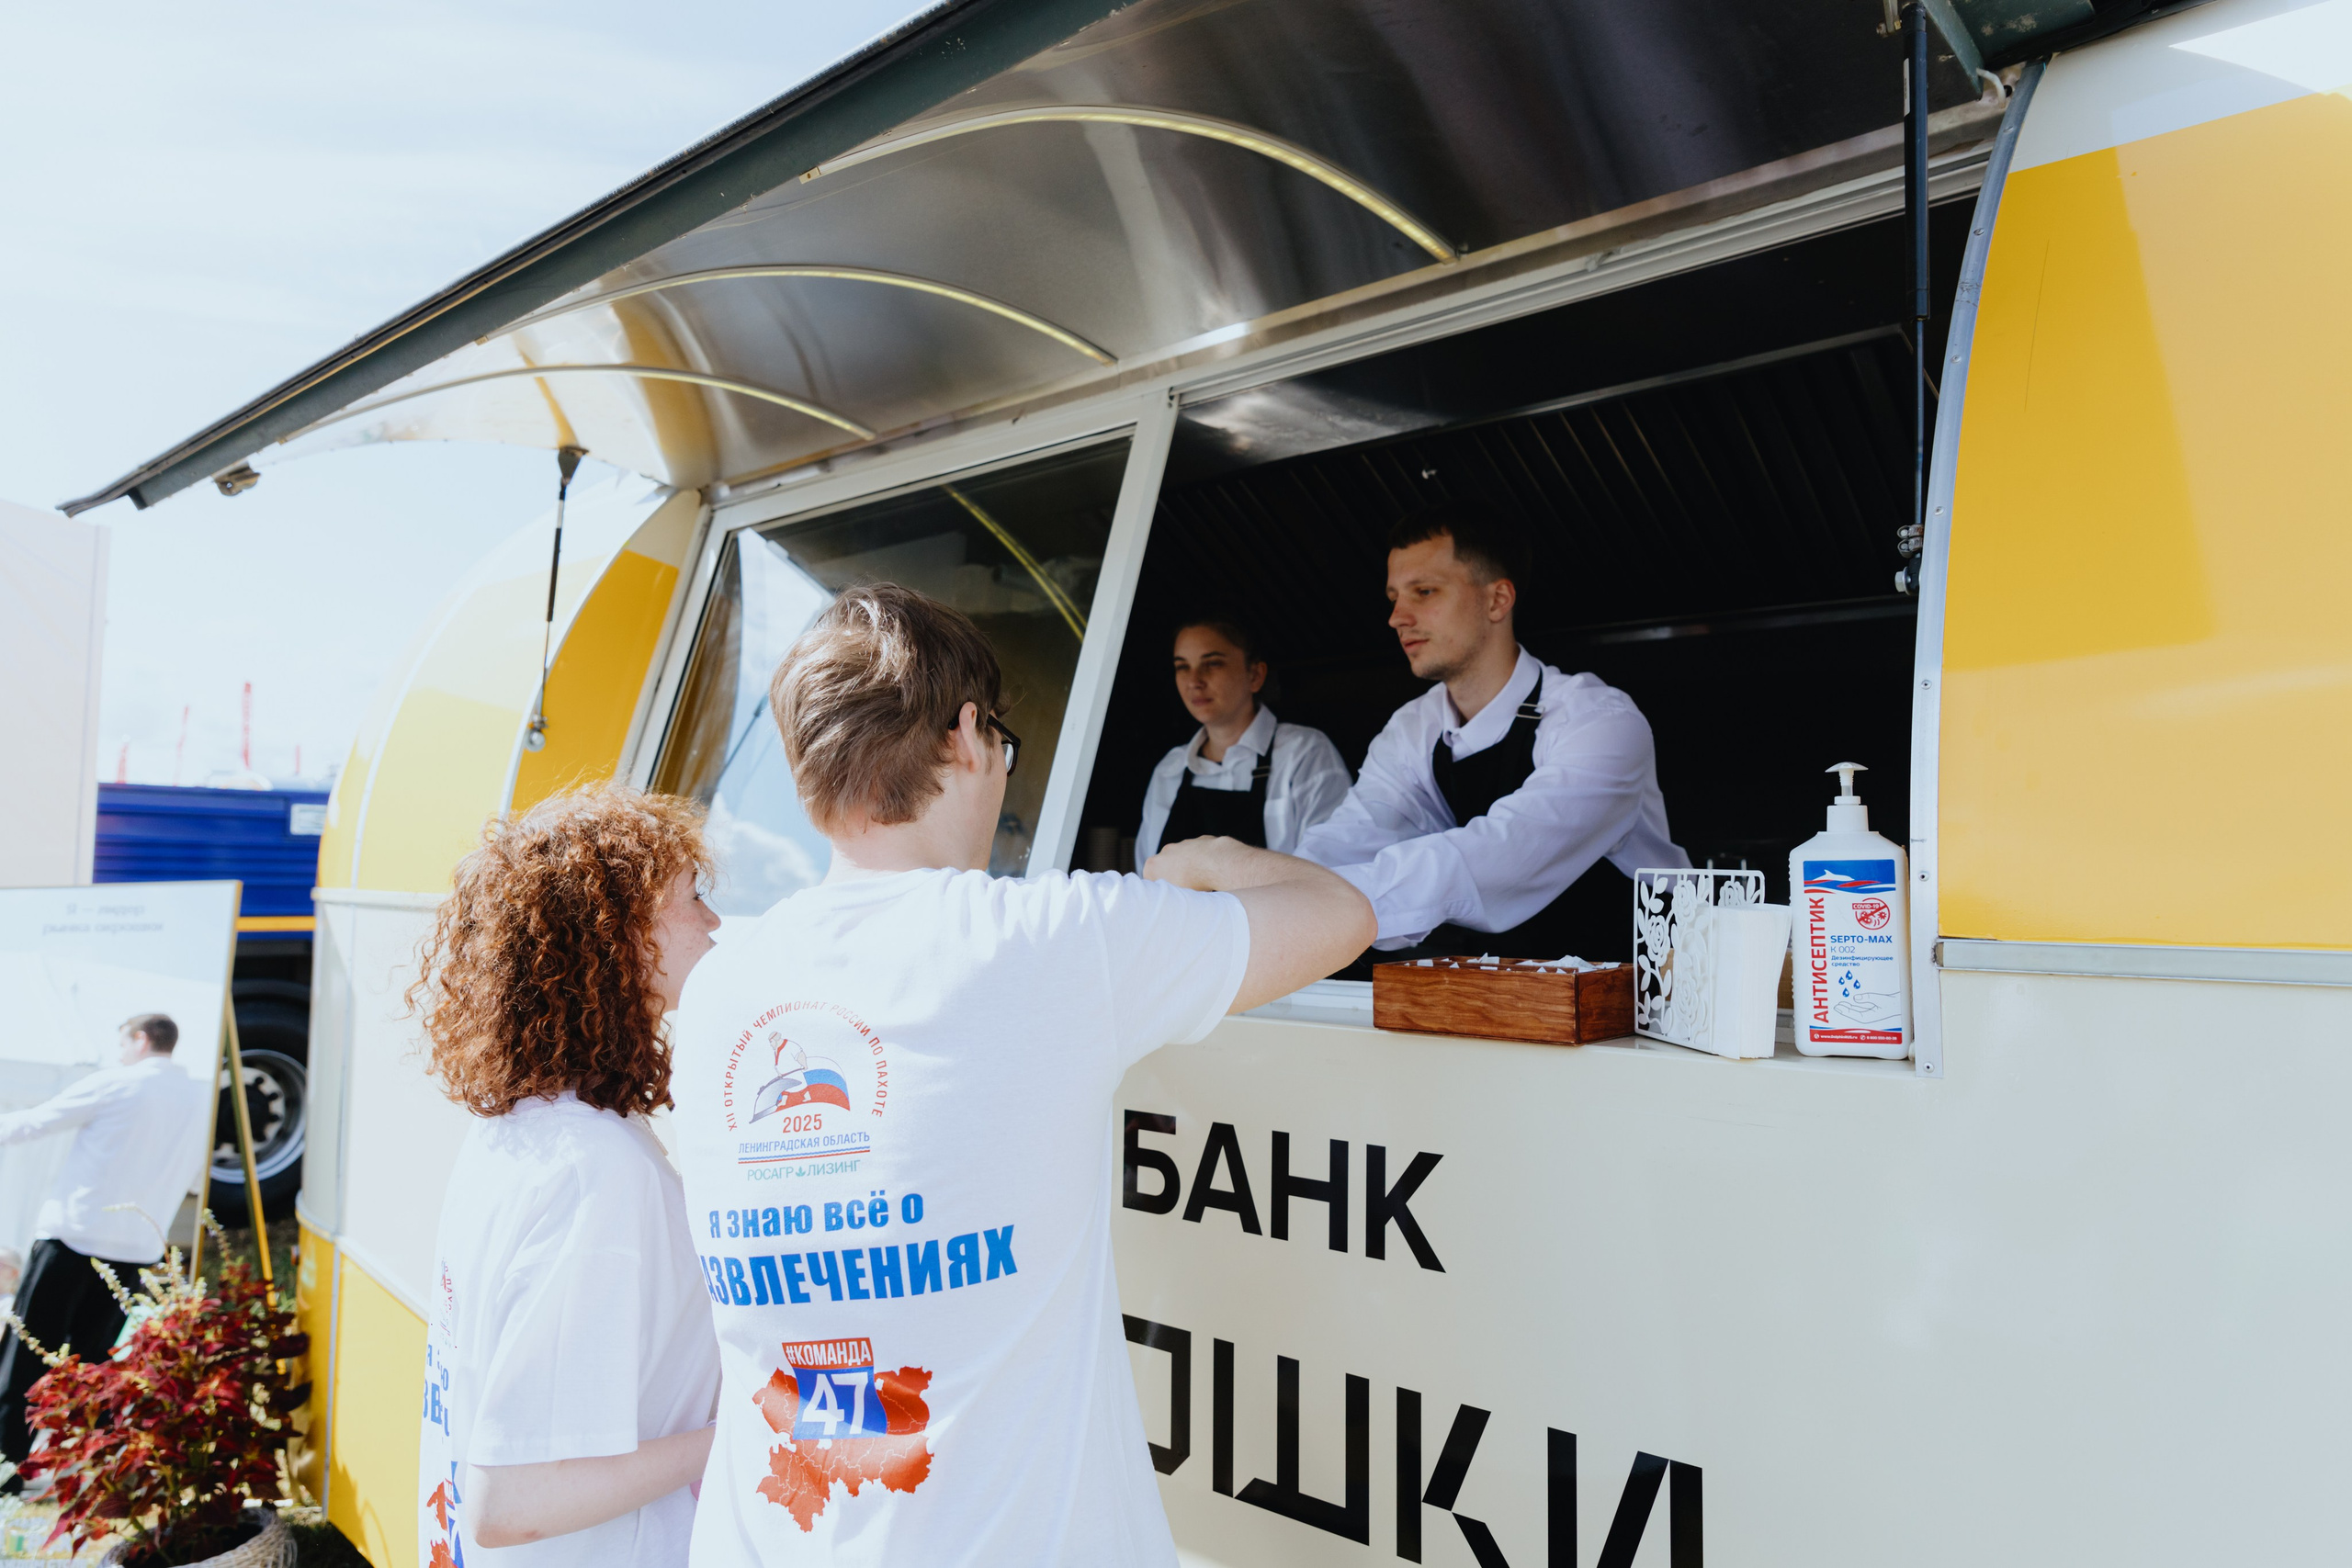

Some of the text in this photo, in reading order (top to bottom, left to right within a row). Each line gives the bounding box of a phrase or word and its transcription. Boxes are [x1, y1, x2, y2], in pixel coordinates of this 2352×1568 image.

[1830, 935, 1893, 943] SEPTO-MAX
[1809, 897, 1828, 1023] АНТИСЕПТИК
[753, 1000, 828, 1029] ЧЕМПИОНАТ
[829, 1004, 871, 1037] РОССИИ
[868, 1036, 884, 1056] ПО
[724, 1030, 753, 1107] ОТКРЫТЫЙ
[871, 1060, 888, 1118] ПАХОТЕ
[783, 1114, 822, 1134] 2025
[738, 1131, 871, 1154] ЛЕНИНГРАДСКАЯ ОБЛАСТЬ
[1123, 1109, 1446, 1273] БАНК
[727, 1203, 813, 1238] знаю
[823, 1190, 889, 1232] всё
[901, 1192, 924, 1224] о
[786, 1340, 872, 1366] #КОМАНДА
[802, 1372, 868, 1435] 47
